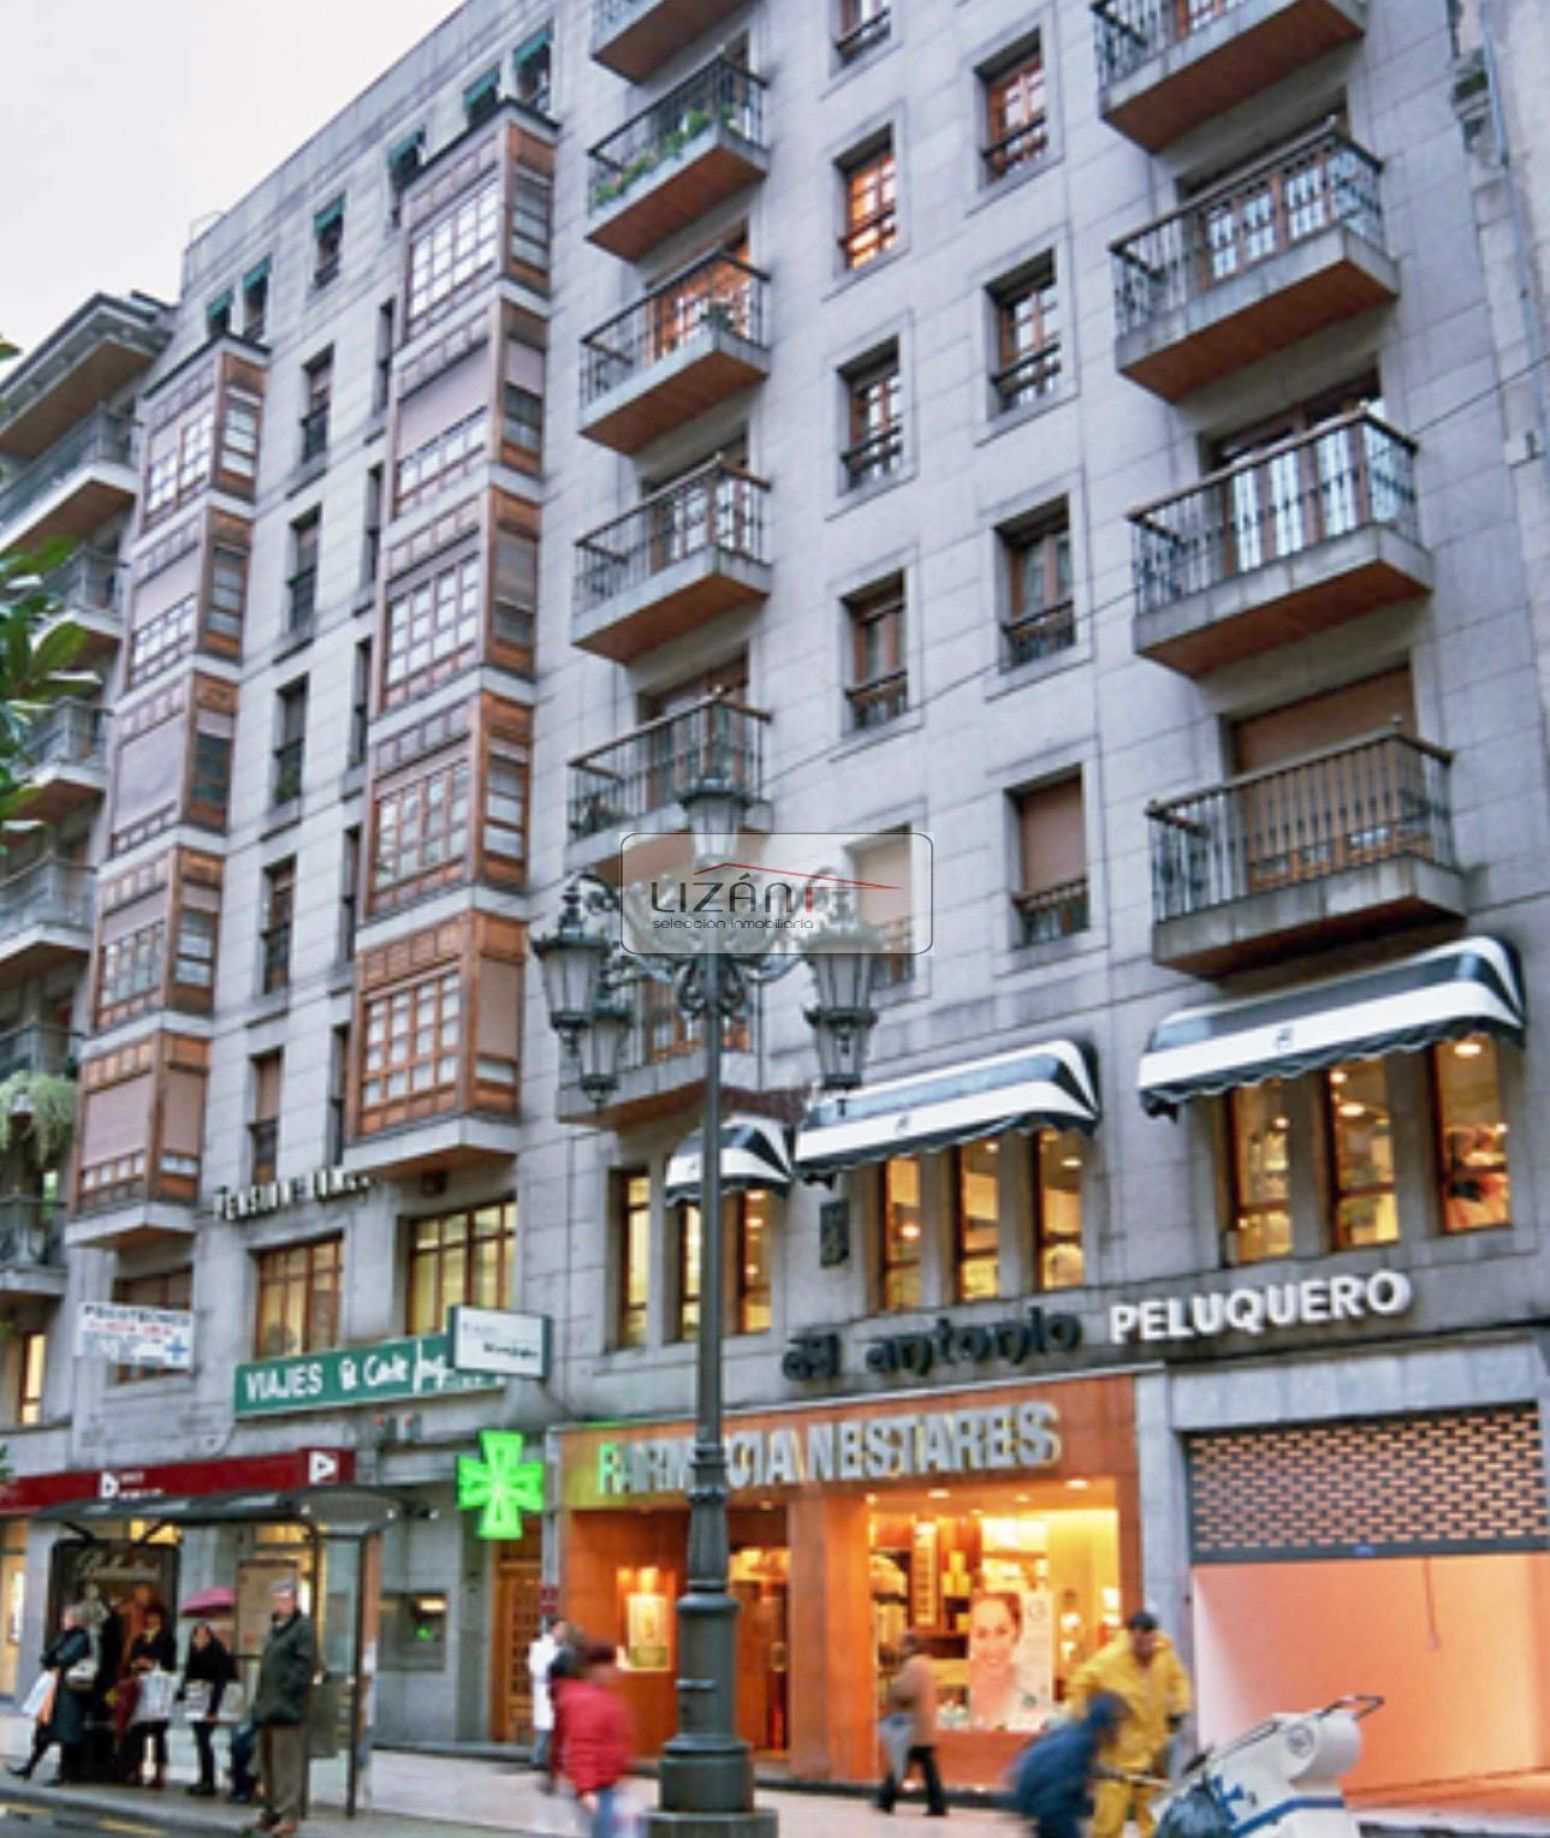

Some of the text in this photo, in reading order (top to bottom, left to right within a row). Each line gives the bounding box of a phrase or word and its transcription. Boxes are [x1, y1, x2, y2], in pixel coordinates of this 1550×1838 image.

[1109, 1270, 1412, 1345] PELUQUERO
[244, 1362, 324, 1402] VIAJES
[599, 1400, 1062, 1496] FARMCIA NESTARES
